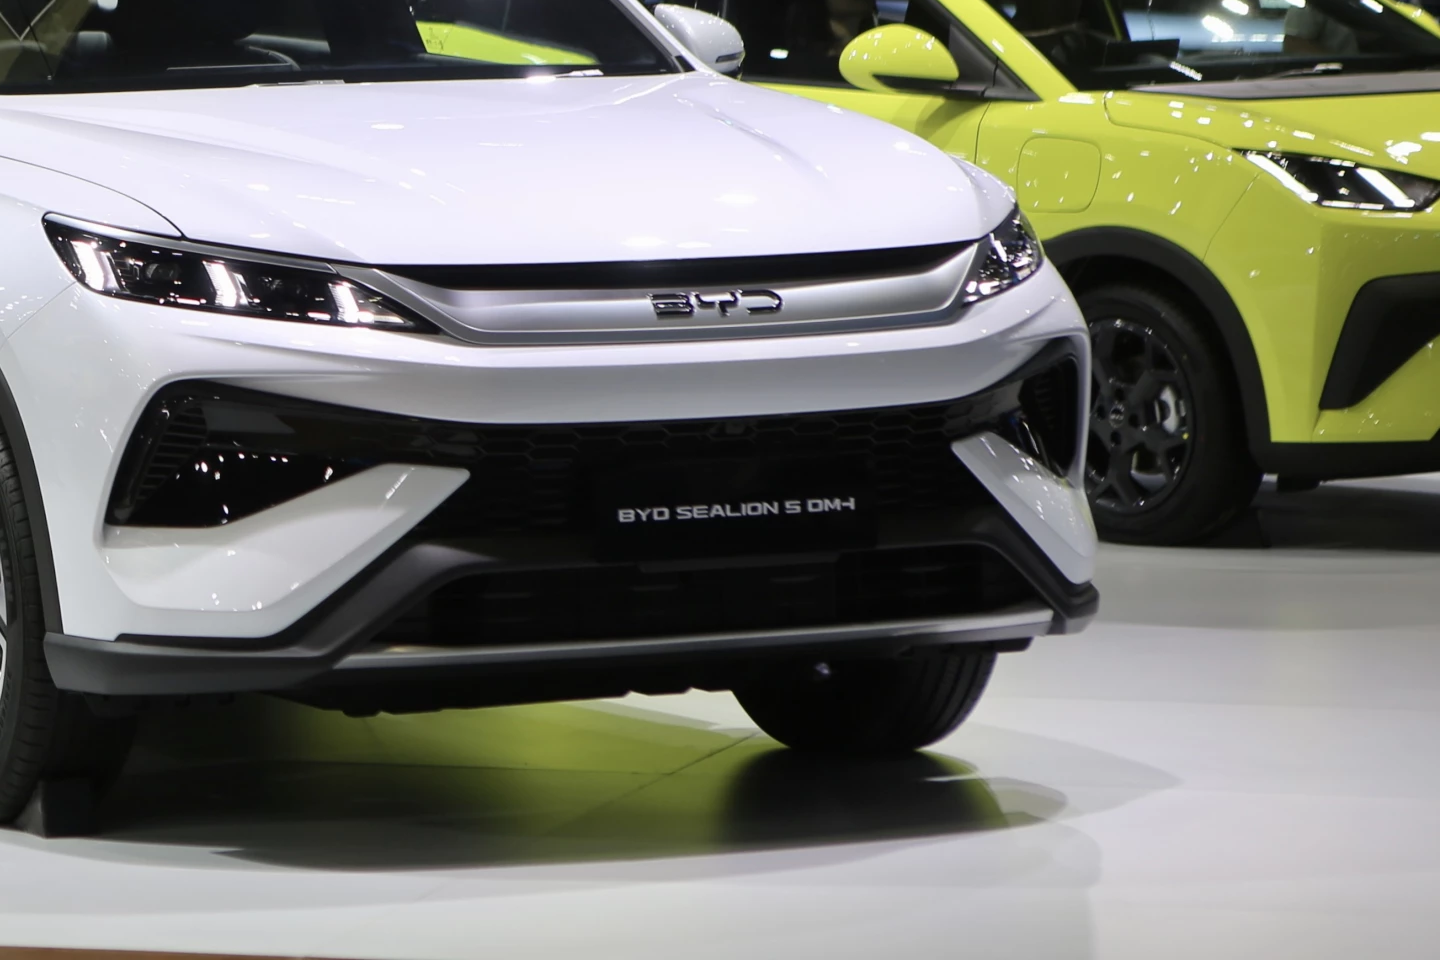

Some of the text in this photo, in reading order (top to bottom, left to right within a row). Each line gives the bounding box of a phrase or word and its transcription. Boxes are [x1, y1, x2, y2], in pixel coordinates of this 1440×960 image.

[648, 289, 784, 320] BYD
[618, 507, 670, 522] BYD
[676, 502, 779, 519] SEALION
[784, 500, 801, 514] 5
